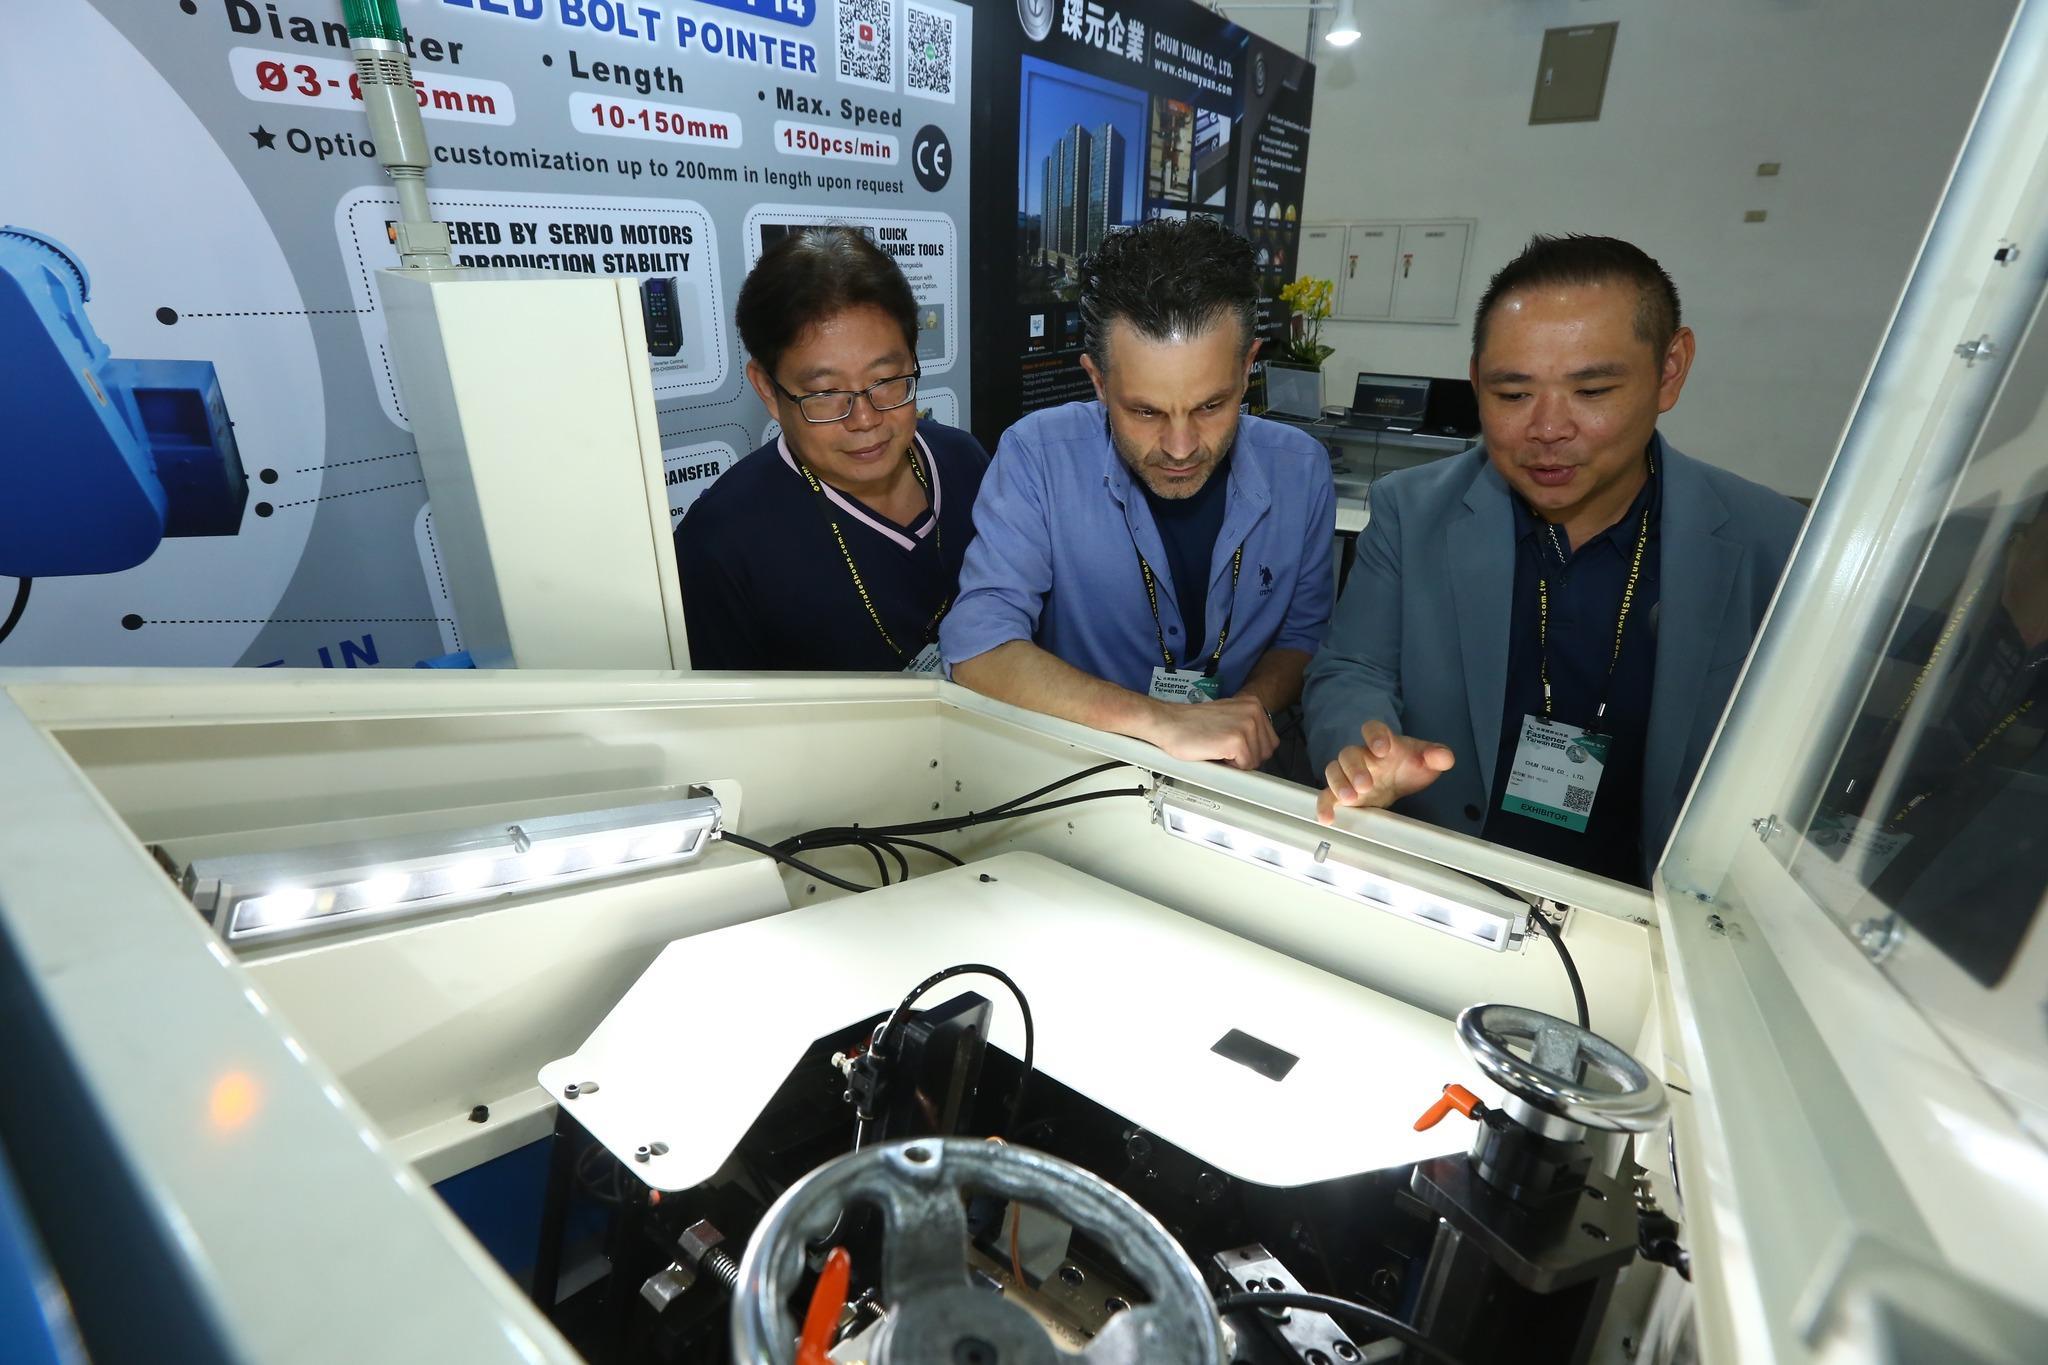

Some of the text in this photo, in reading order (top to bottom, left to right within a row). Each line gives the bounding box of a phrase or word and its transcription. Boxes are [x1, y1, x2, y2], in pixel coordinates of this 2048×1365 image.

[224, 0, 464, 65] Diamter
[559, 0, 817, 74] BOLT POINTER
[1154, 32, 1234, 79] CHUM YUAN CO., LTD.
[569, 50, 684, 95] Length
[1154, 58, 1233, 97] www.chumyuan.com
[591, 103, 729, 140] 10-150mm
[776, 86, 902, 129] Max. Speed
[783, 128, 891, 159] 150pcs/min
[286, 127, 904, 195] Optio customization up to 200mm in length upon request
[509, 222, 538, 245] BY
[549, 223, 614, 245] SERVO
[621, 224, 693, 246] MOTORS
[879, 227, 908, 241] QUICK
[603, 252, 690, 274] STABILITY
[917, 243, 945, 257] TOOLS
[664, 461, 720, 487] ANSFER
[317, 633, 380, 668] IN
[1154, 680, 1188, 690] Fastener
[1525, 736, 1551, 748] Taiwan
[1526, 730, 1567, 745] Fastener
[1520, 803, 1568, 823] EXHIBITOR
